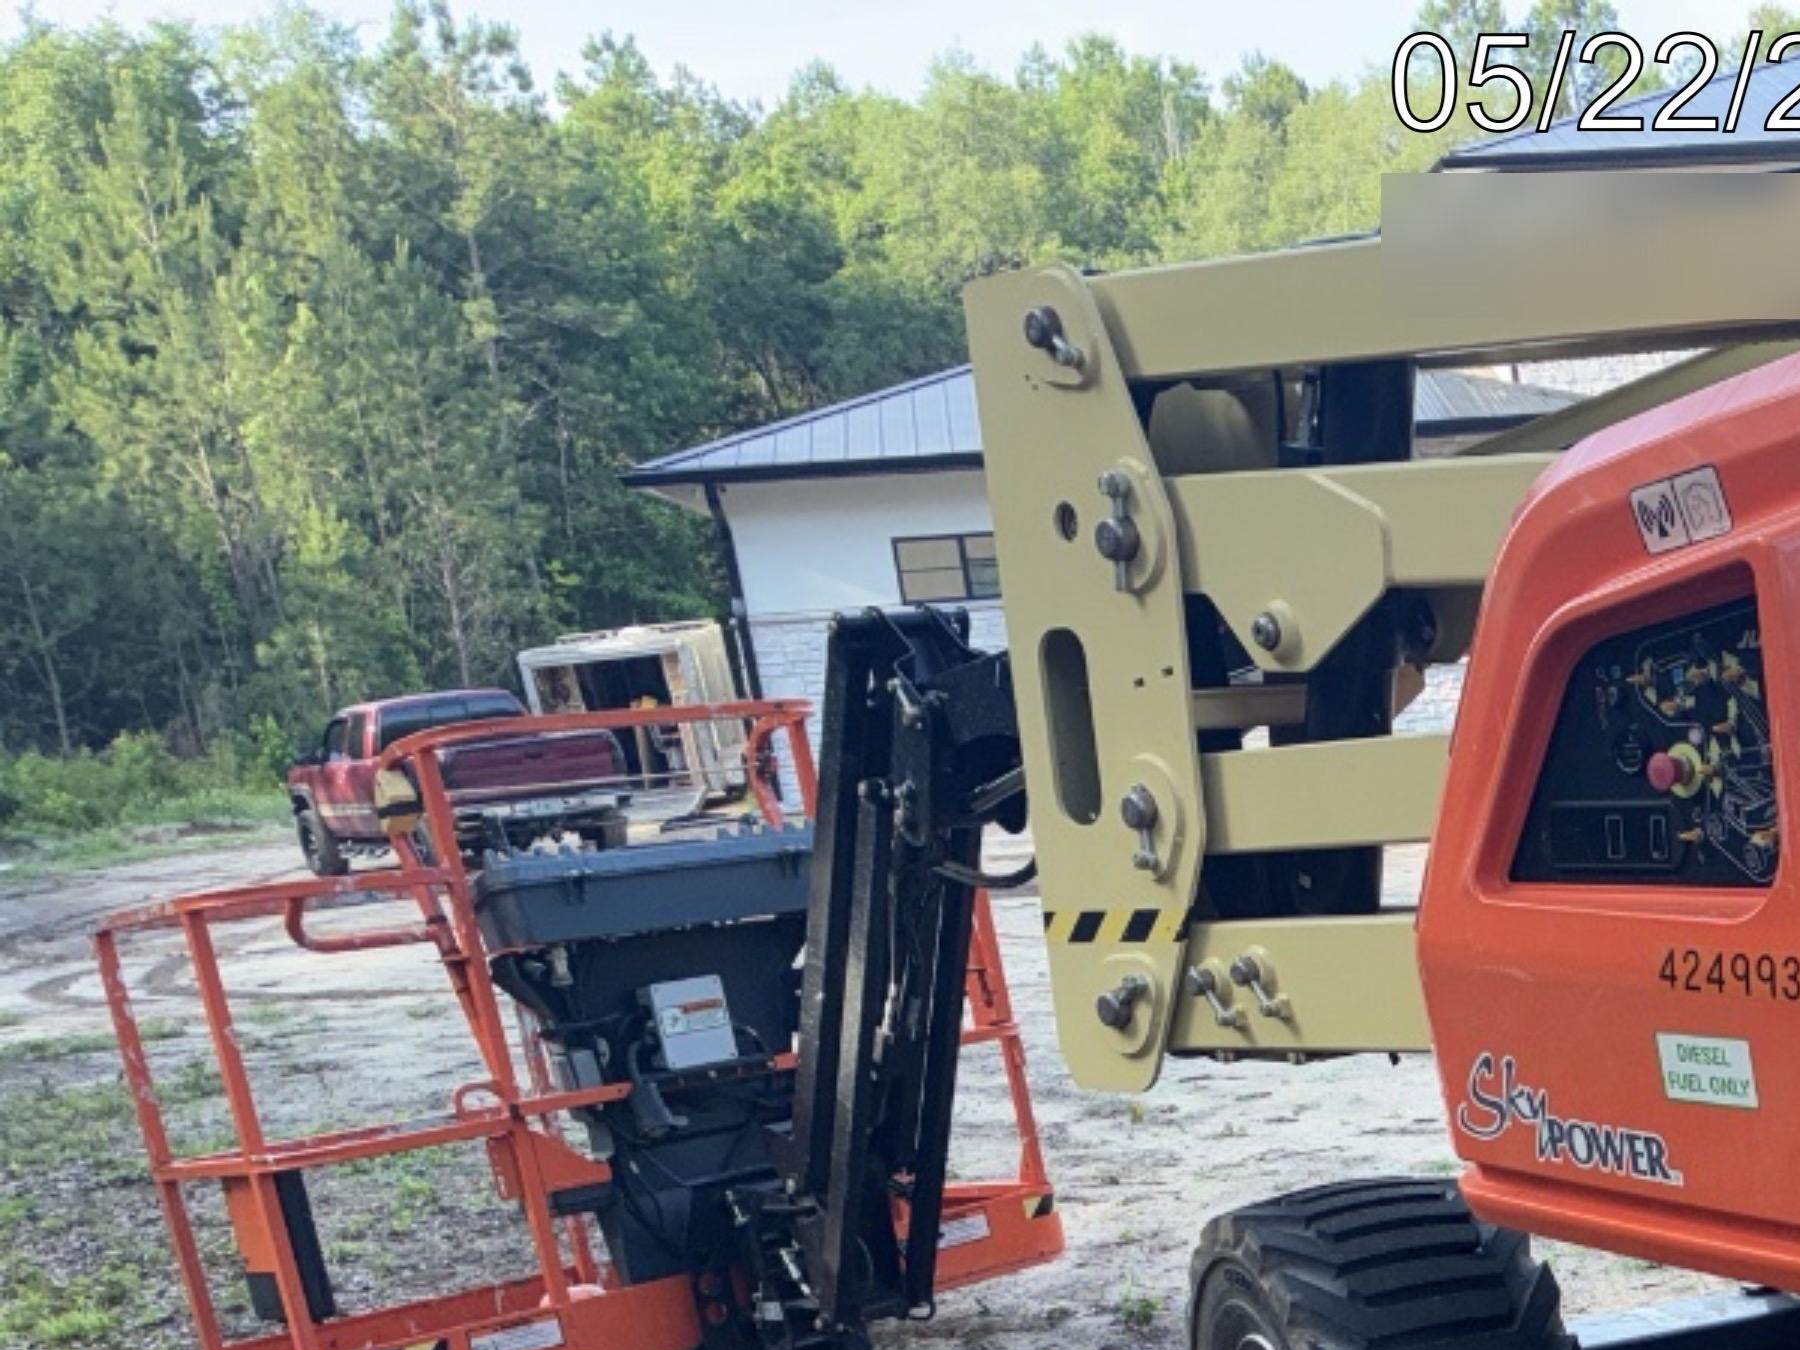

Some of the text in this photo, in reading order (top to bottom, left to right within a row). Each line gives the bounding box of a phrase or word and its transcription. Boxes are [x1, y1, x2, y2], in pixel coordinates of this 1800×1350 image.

[1675, 1042, 1732, 1067] DIESEL
[1666, 1071, 1751, 1098] FUEL ONLY
